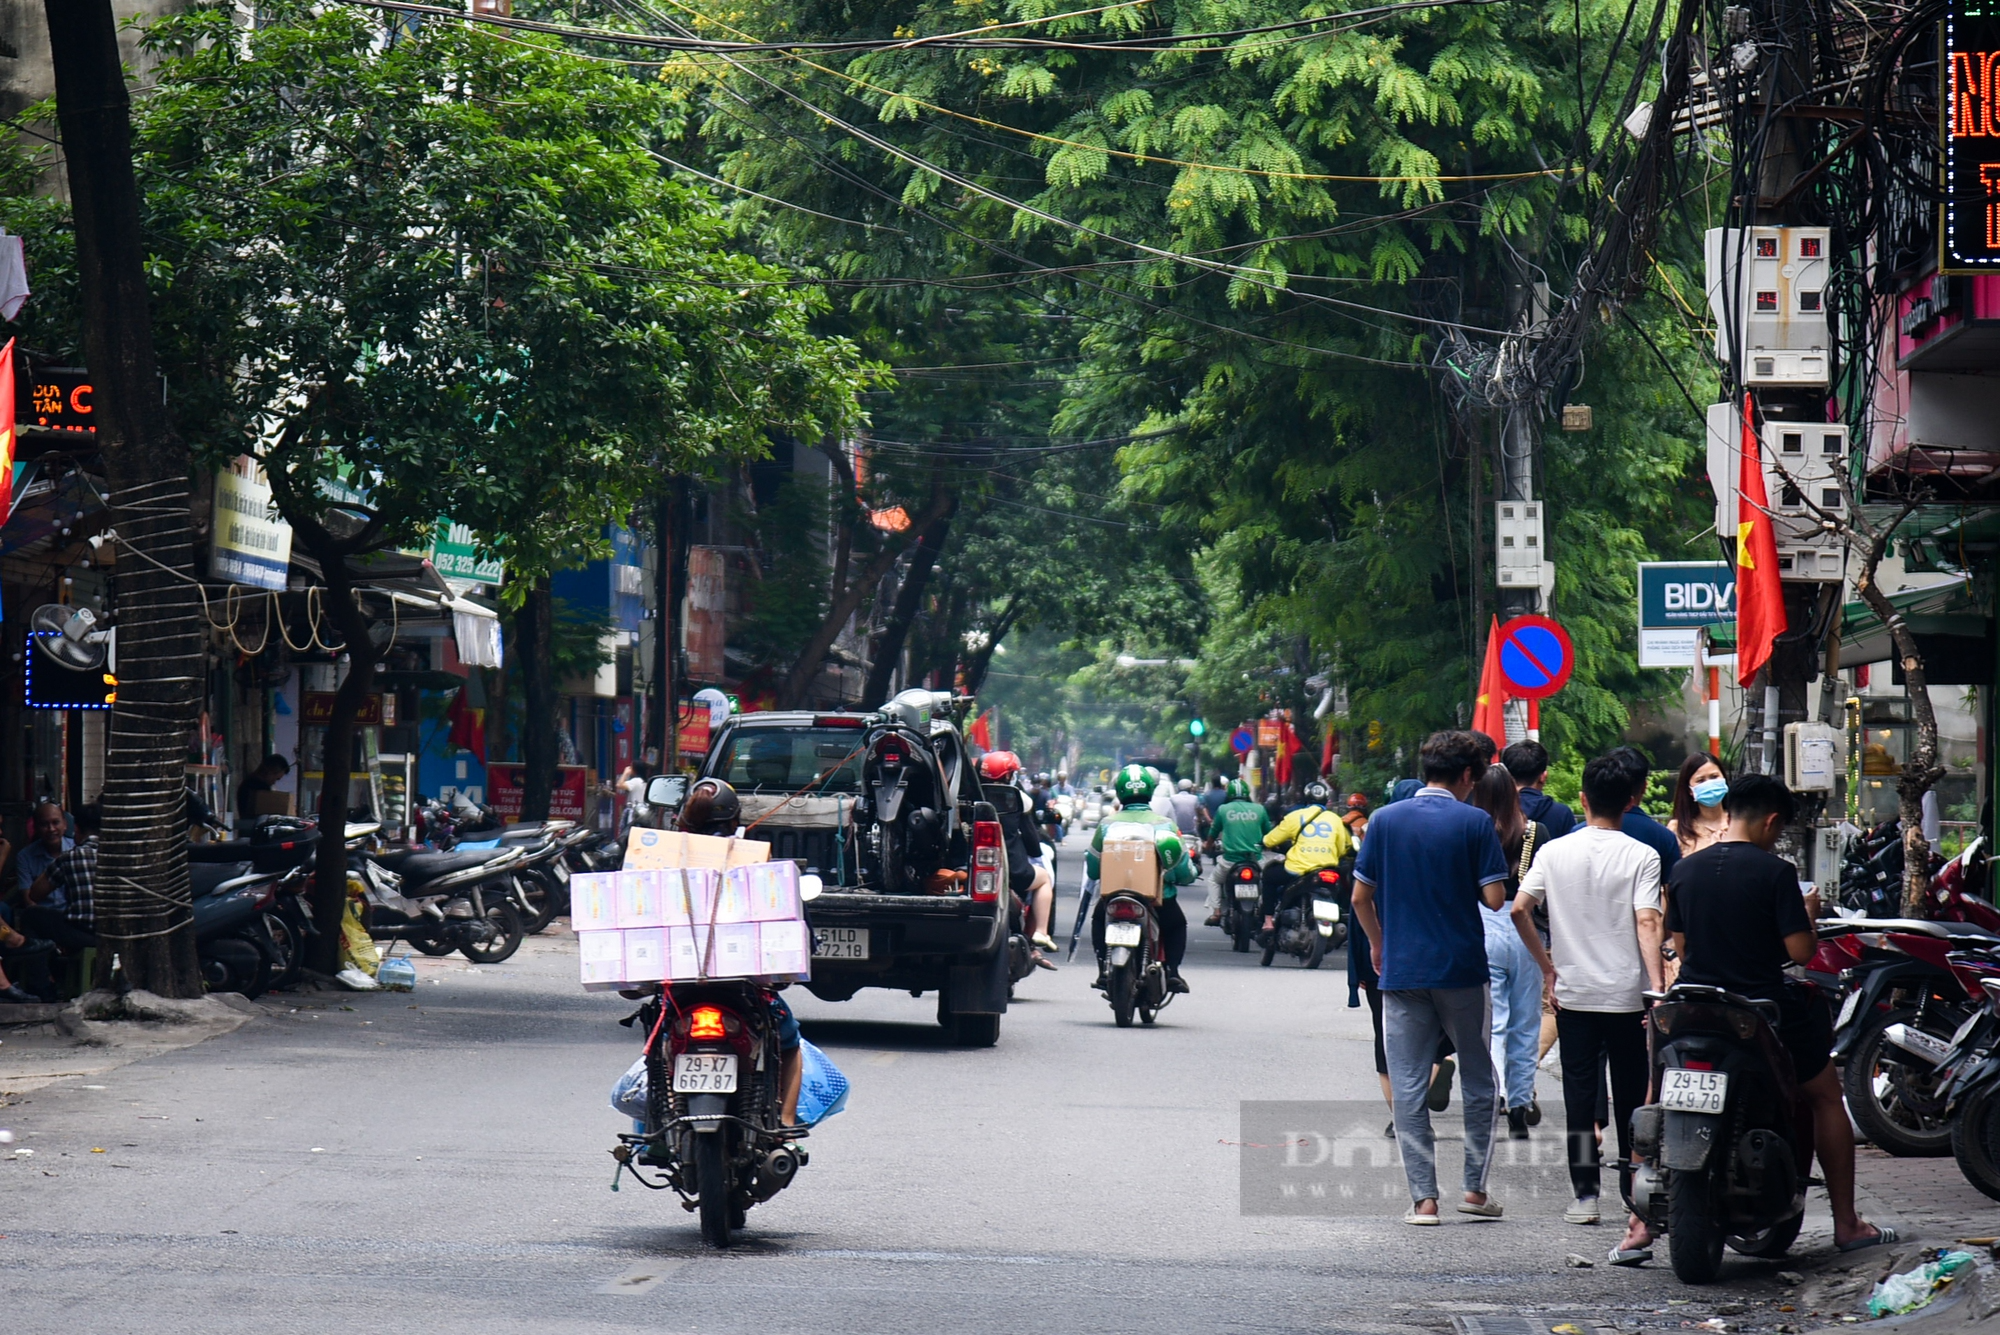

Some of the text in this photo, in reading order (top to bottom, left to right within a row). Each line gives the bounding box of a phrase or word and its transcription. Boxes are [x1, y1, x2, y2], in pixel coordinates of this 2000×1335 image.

[435, 552, 454, 571] 052
[455, 555, 475, 573] 325
[1665, 582, 1735, 610] BIDV
[1125, 781, 1147, 789] Grab
[1226, 810, 1258, 821] Grab
[1300, 814, 1333, 839] be
[814, 944, 862, 957] 72.18
[685, 1057, 728, 1072] 29-X7
[680, 1074, 732, 1090] 667.87
[1673, 1072, 1718, 1091] 29-L5
[1665, 1090, 1720, 1110] 249.78
